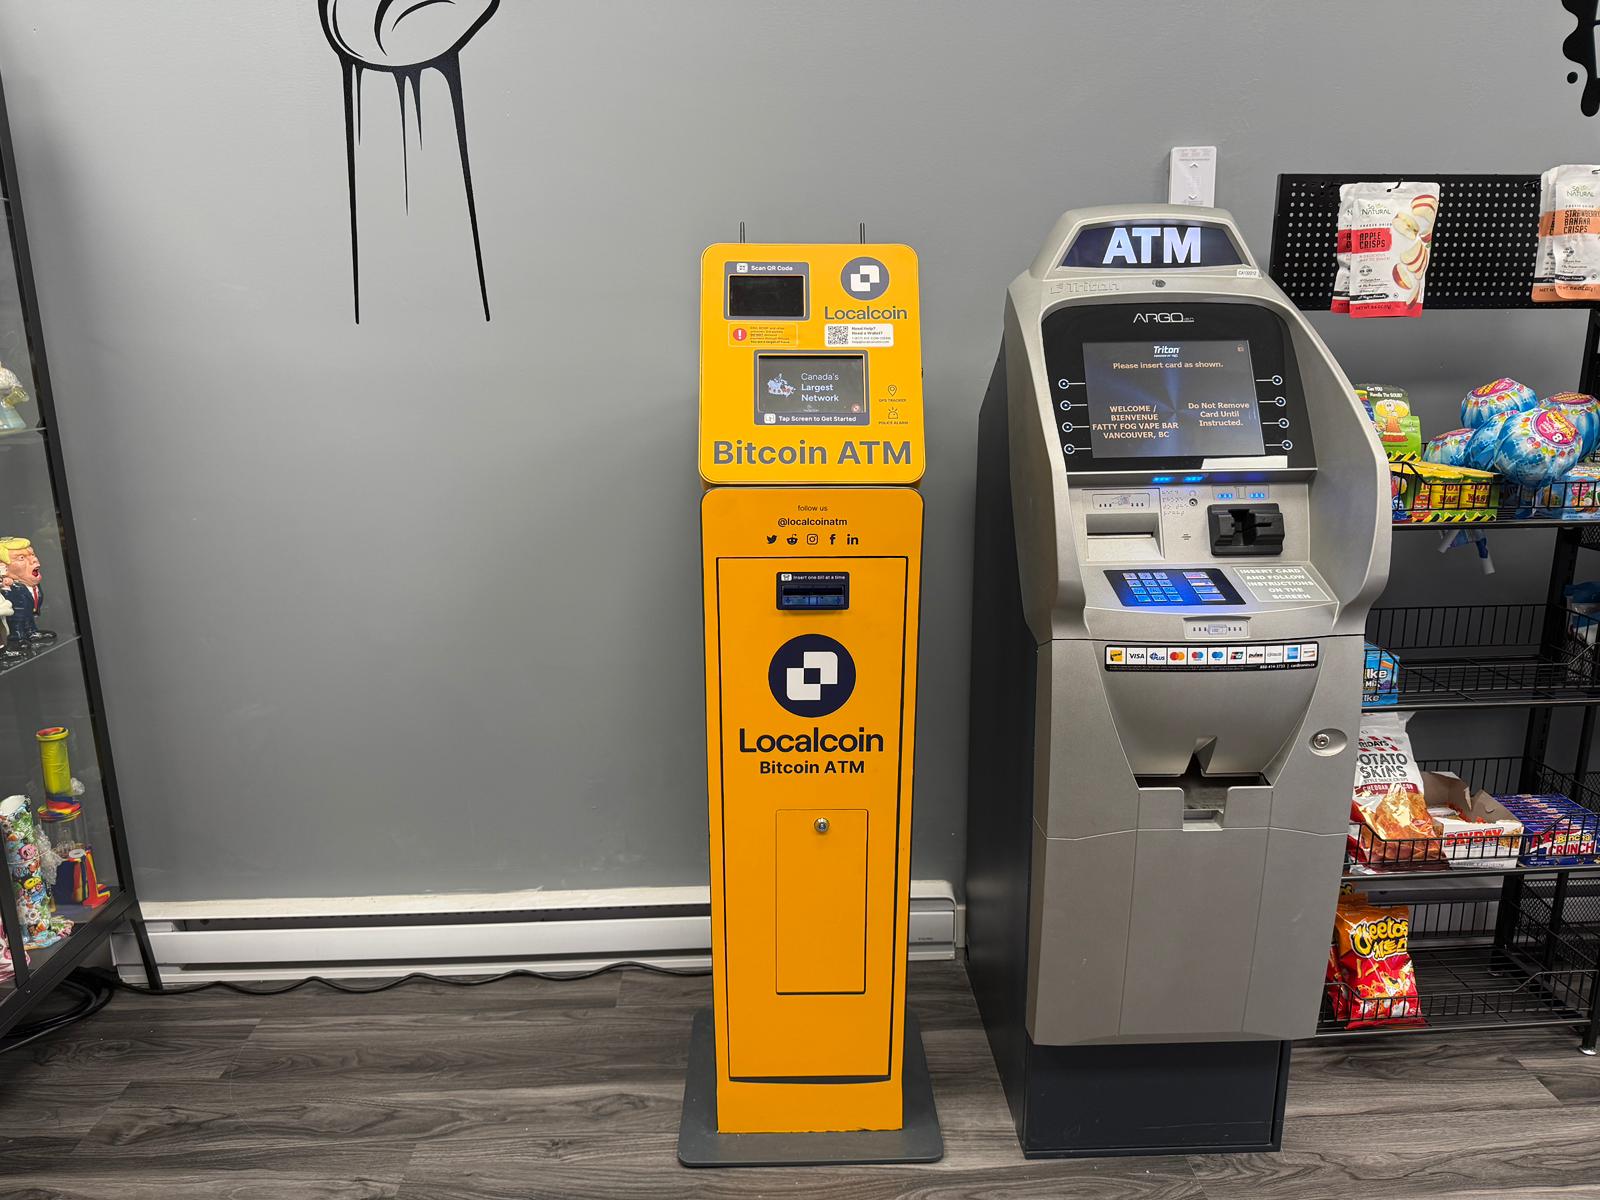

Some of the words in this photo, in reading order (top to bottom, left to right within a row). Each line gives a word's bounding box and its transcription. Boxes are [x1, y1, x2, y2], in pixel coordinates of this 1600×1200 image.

[1565, 218, 1590, 226] BANANA
[1564, 226, 1587, 234] CRISPS
[1360, 232, 1381, 240] APPLE
[1102, 227, 1201, 264] ATM
[1360, 240, 1385, 249] CRISPS
[825, 306, 908, 320] Localcoin
[1133, 312, 1183, 323] ARGO
[1154, 346, 1179, 354] Triton
[1113, 362, 1138, 370] Please
[801, 384, 833, 392] Largest
[1109, 405, 1151, 413] WELCOME
[1111, 414, 1158, 422] BIENVENUE
[1221, 410, 1240, 418] Until
[1162, 422, 1179, 430] BAR
[1103, 431, 1156, 440] VANCOUVER,
[714, 440, 827, 464] Bitcoin
[838, 441, 911, 464] ATM
[777, 518, 847, 527] @localcoinatm
[740, 727, 883, 752] Localcoin
[1358, 740, 1389, 748] RIDAYS
[1357, 753, 1408, 765] OTATO
[760, 761, 819, 773] Bitcoin
[824, 761, 864, 773] ATM
[1360, 765, 1407, 778] SKINS
[1444, 827, 1504, 847] PAYDAY
